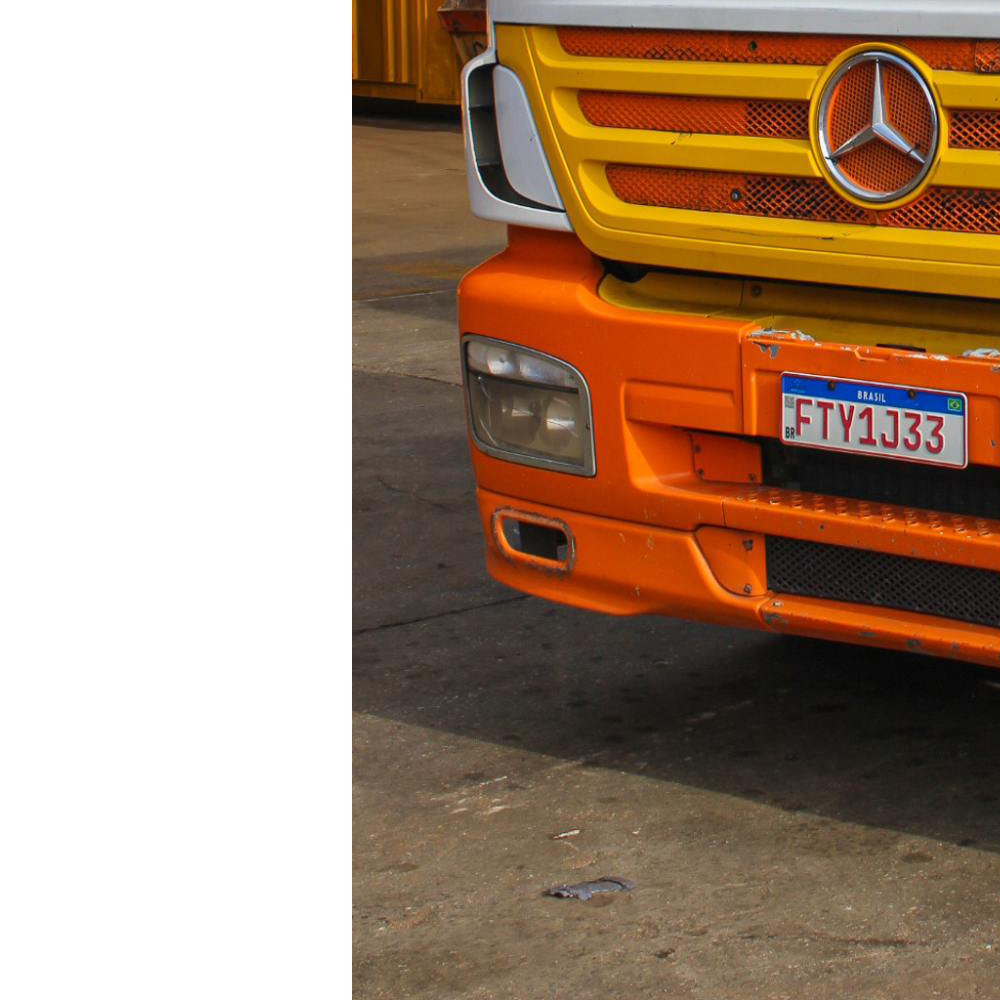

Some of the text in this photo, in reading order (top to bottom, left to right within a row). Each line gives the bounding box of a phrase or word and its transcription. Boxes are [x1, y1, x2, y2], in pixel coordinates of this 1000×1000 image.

[857, 390, 886, 403] BRASIL
[785, 426, 796, 440] BR
[796, 398, 945, 454] FTY1J33
